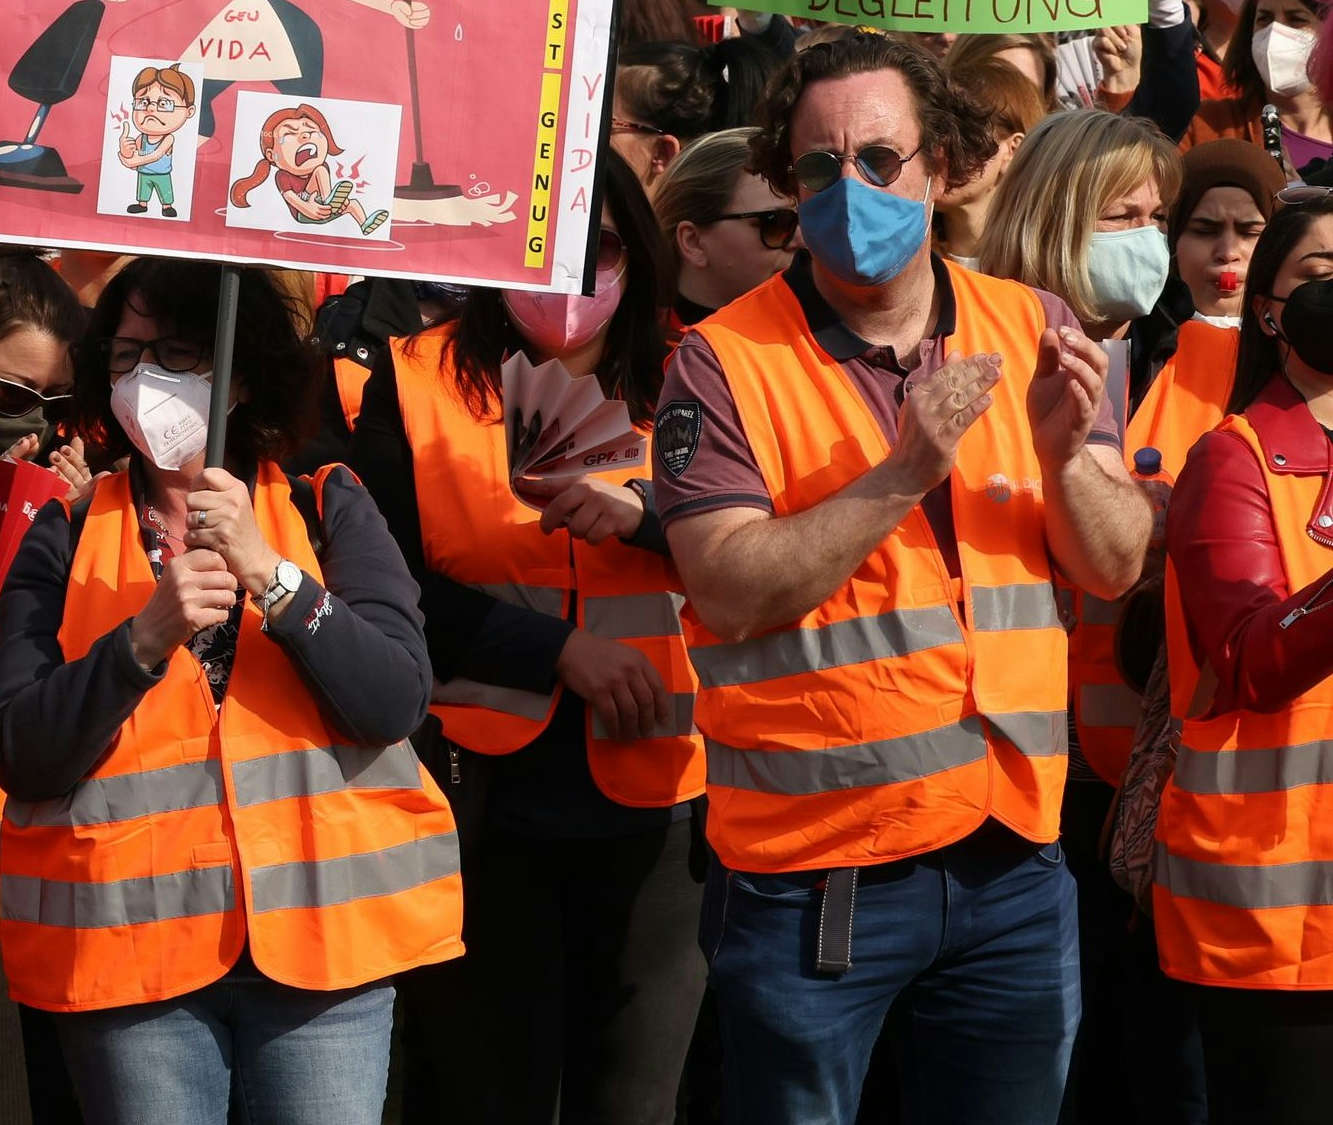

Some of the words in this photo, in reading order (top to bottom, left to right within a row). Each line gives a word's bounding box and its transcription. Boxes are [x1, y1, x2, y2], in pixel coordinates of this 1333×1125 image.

[199, 37, 272, 63] VIDA
[528, 111, 556, 253] GENUG
[569, 73, 604, 214] VIDA
